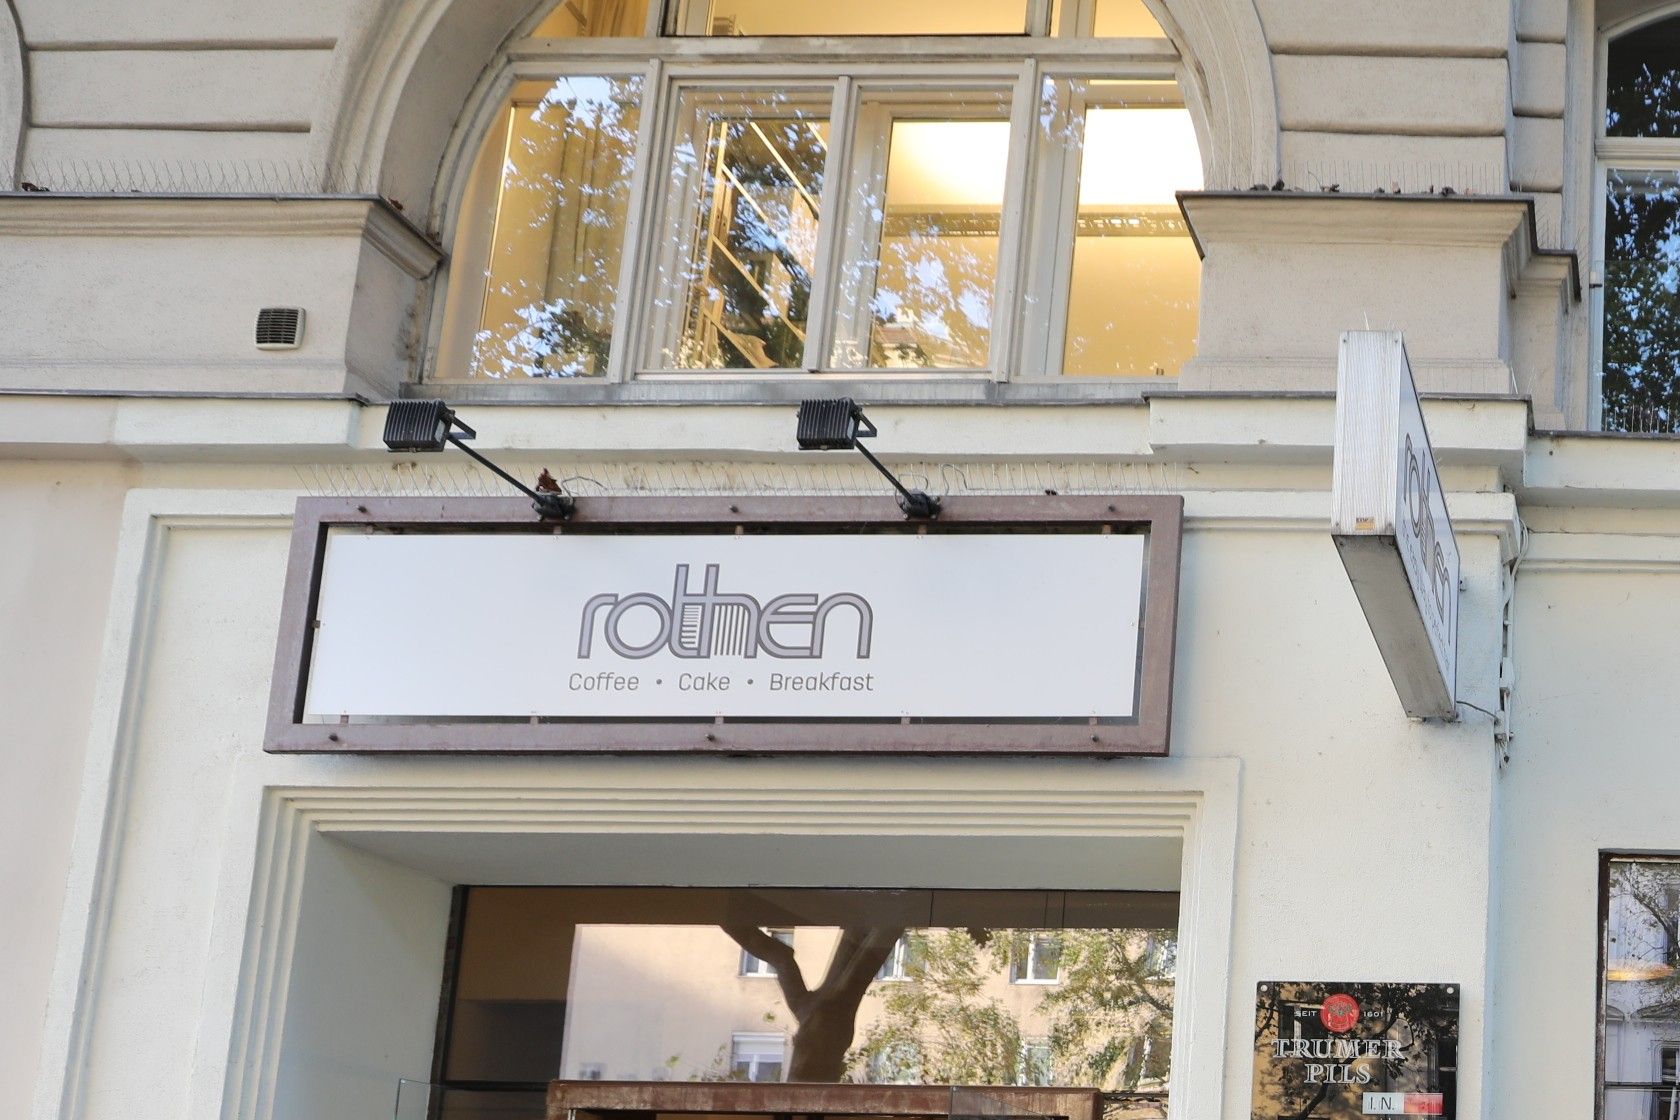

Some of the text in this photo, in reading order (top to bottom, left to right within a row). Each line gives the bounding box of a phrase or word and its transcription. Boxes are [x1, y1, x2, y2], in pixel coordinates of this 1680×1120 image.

[577, 563, 874, 660] rothen
[568, 671, 875, 692] Coffee Cake Breakfast
[1293, 1010, 1318, 1018] SEIT
[1271, 1038, 1406, 1060] TRUMER
[1303, 1063, 1372, 1085] PILS
